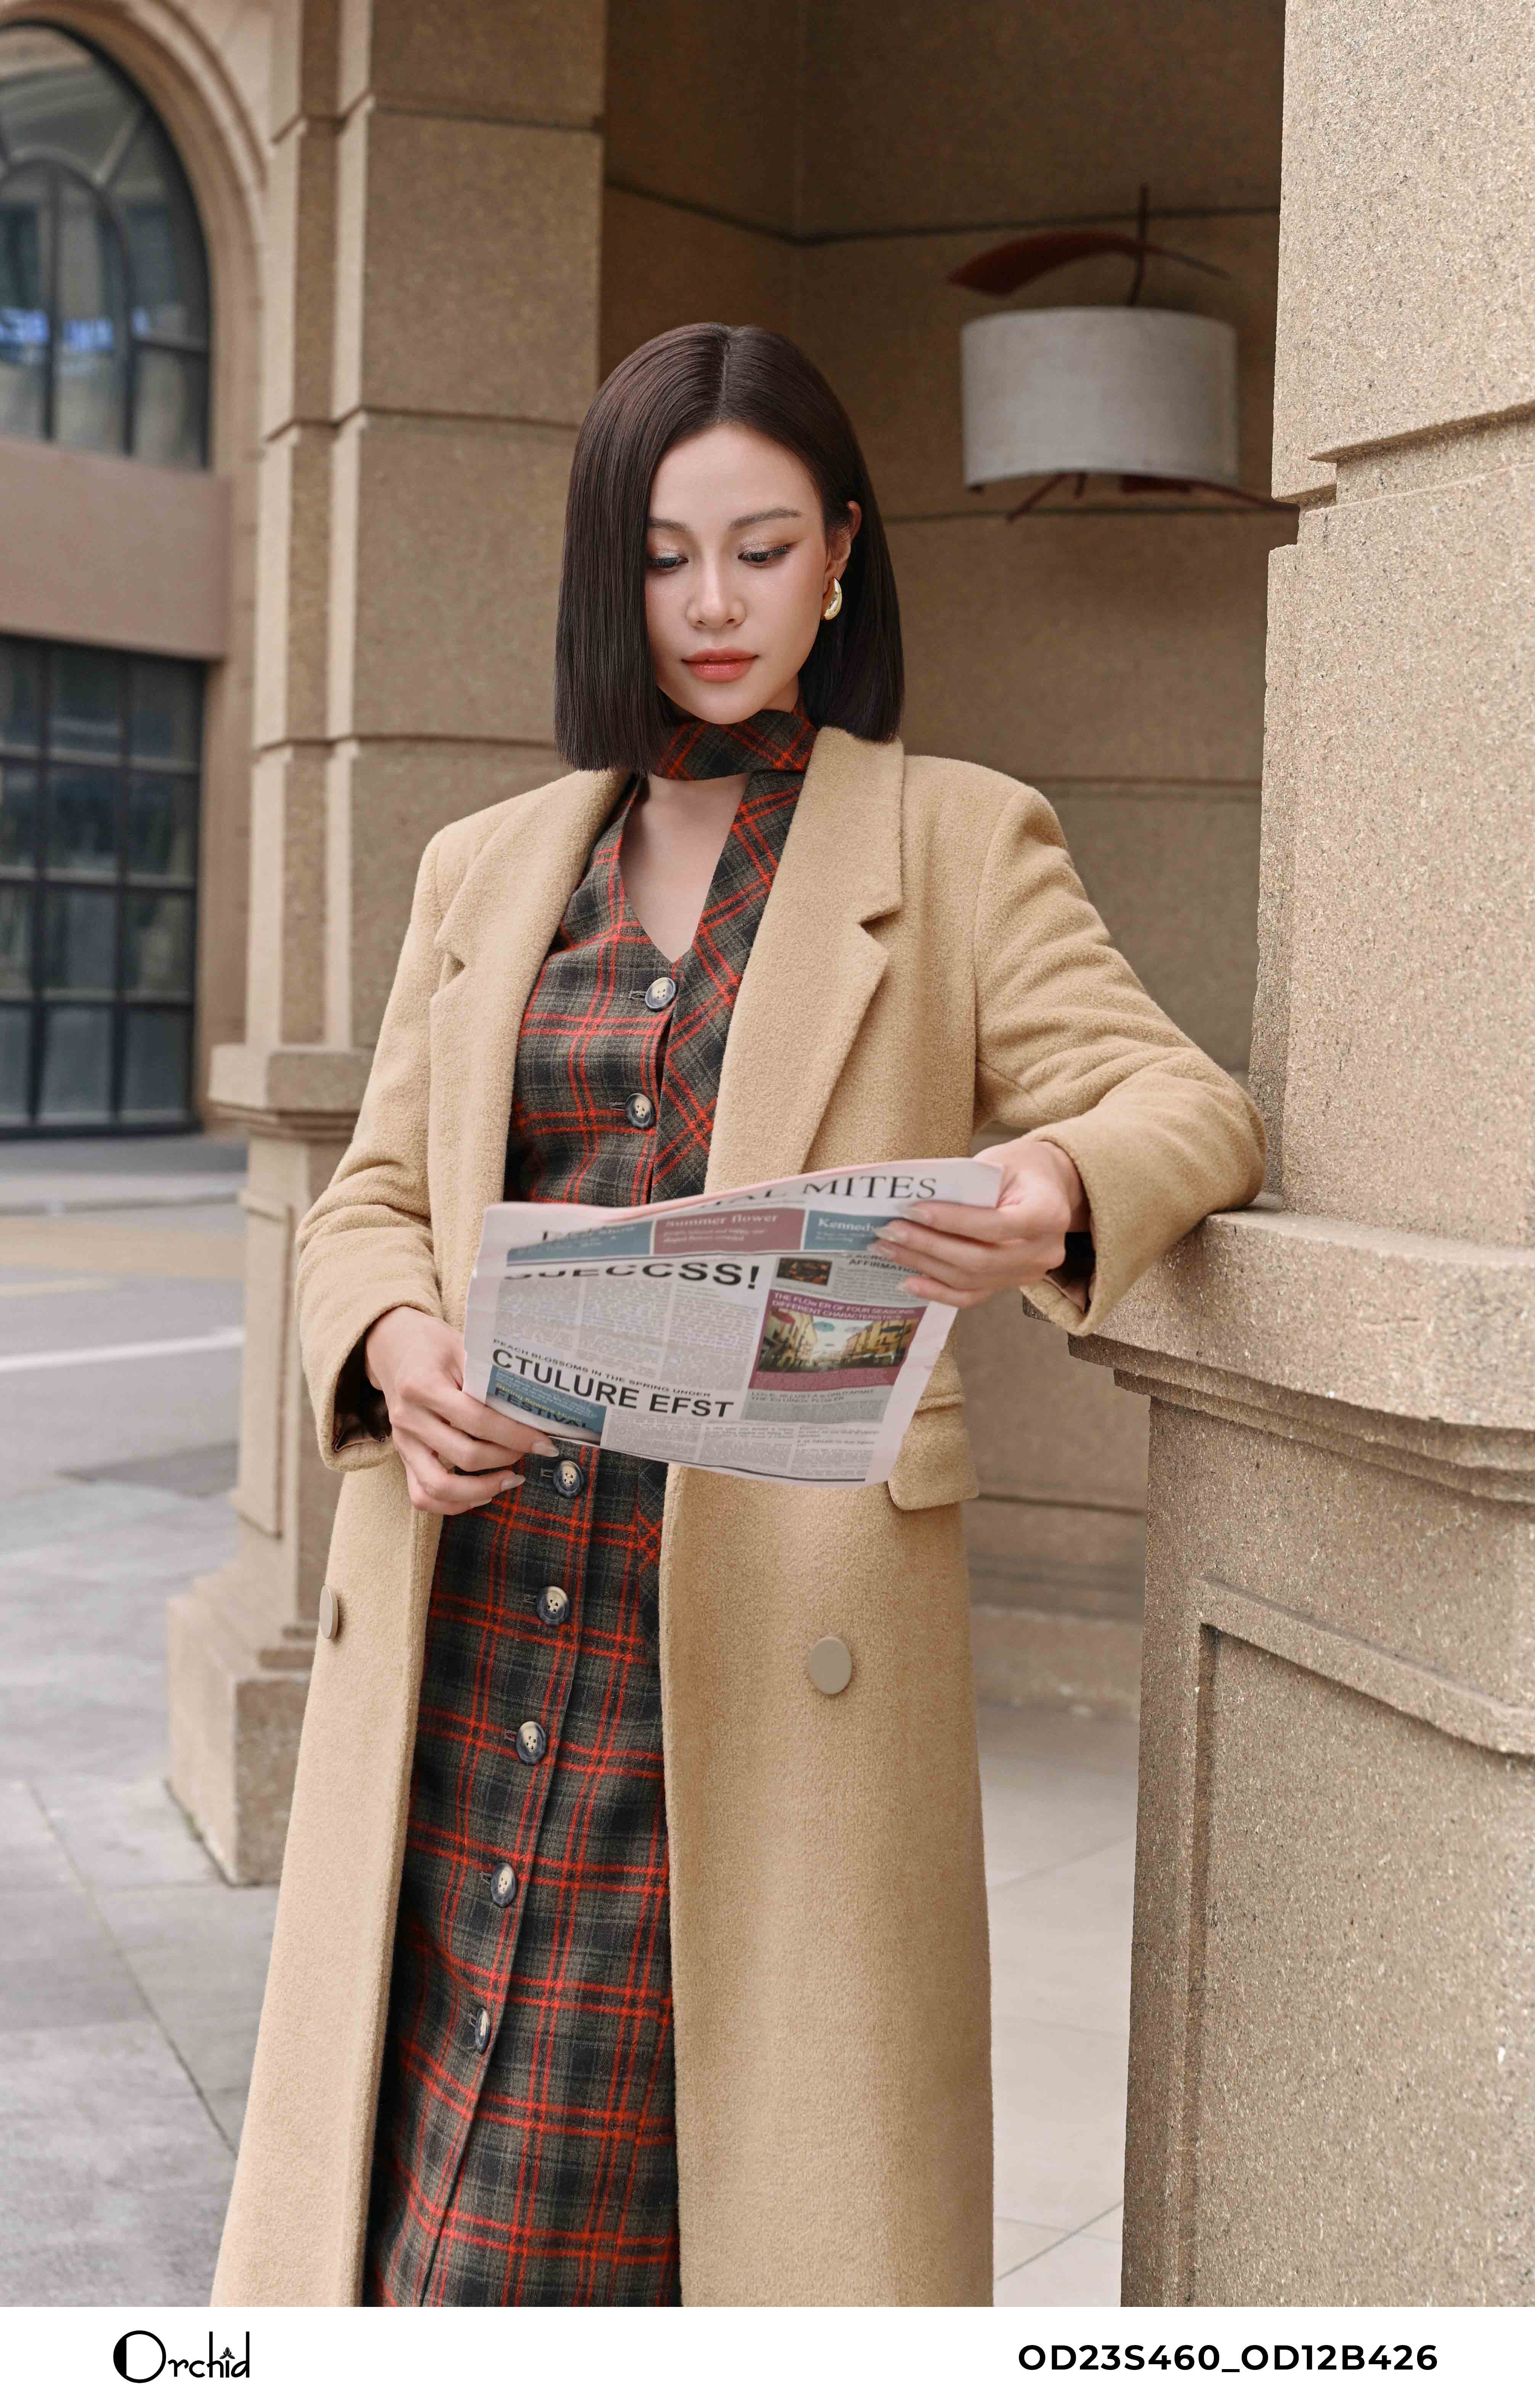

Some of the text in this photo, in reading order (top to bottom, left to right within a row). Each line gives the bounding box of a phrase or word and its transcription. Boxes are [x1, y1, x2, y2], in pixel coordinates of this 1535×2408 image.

[803, 1176, 936, 1200] MITES
[732, 1214, 778, 1223] flower
[819, 1218, 872, 1232] Kenned
[772, 1300, 822, 1315] DIFFERENT
[493, 1339, 711, 1397] PEACH BLOSSOMS IN THE SPRING UNDER
[492, 1348, 640, 1409] CTULURE
[649, 1393, 734, 1418] EFST
